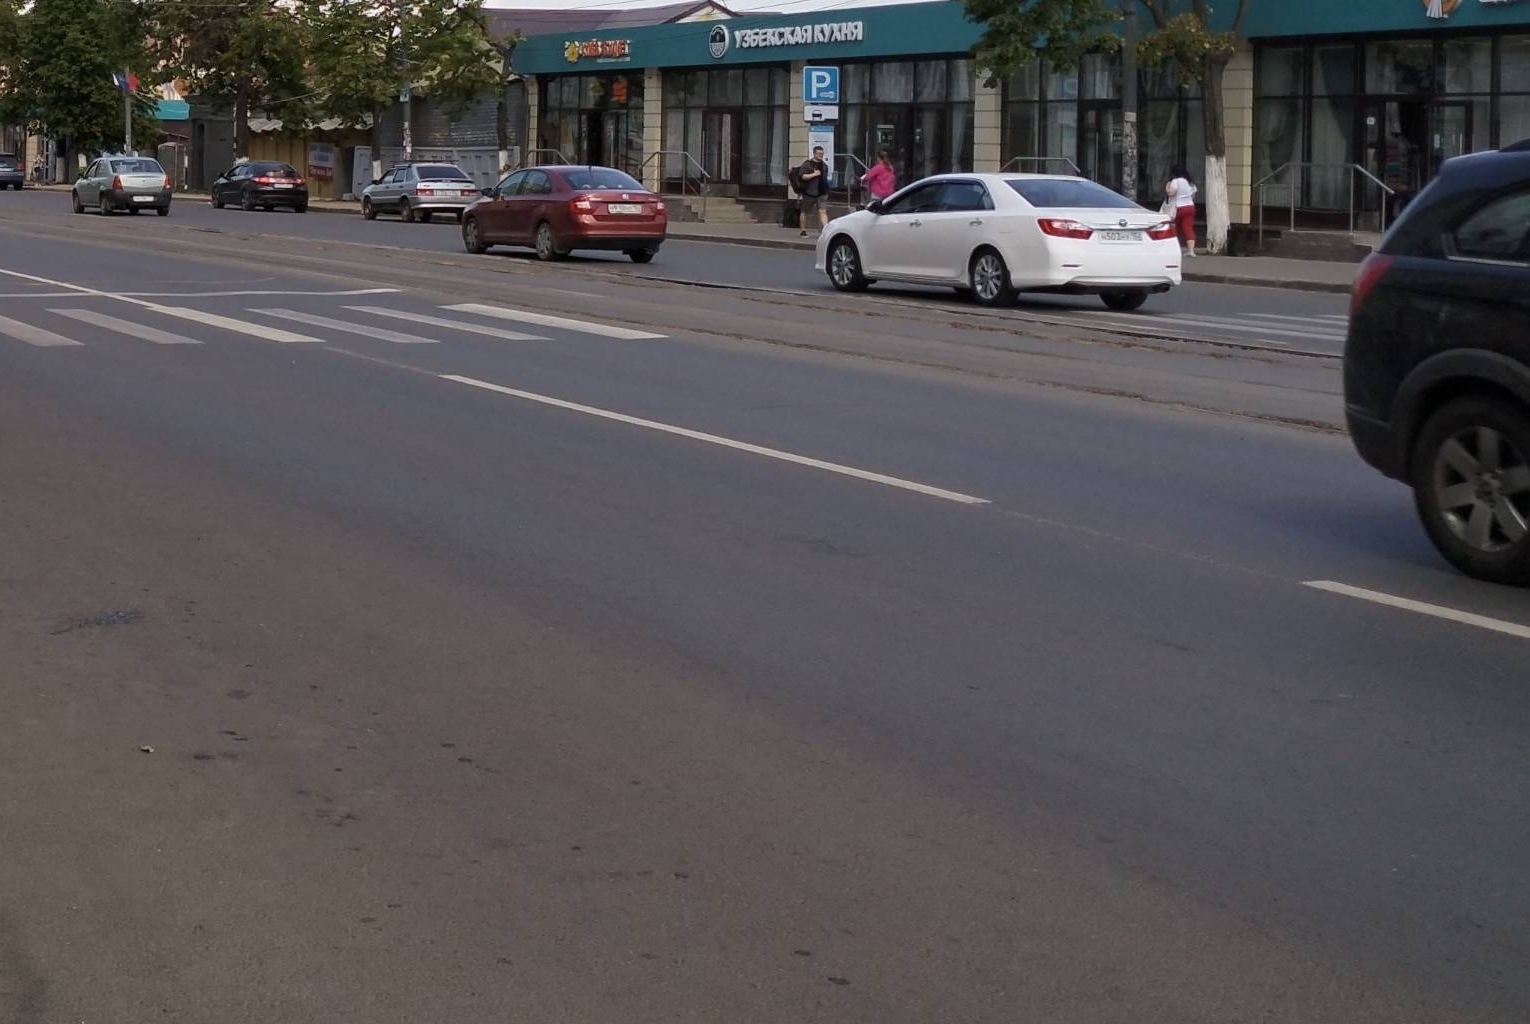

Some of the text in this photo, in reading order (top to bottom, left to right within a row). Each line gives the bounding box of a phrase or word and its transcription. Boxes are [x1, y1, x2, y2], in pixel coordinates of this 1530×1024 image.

[734, 21, 864, 49] УЗБЕКСКАЯ КУХНЯ
[811, 71, 831, 98] P
